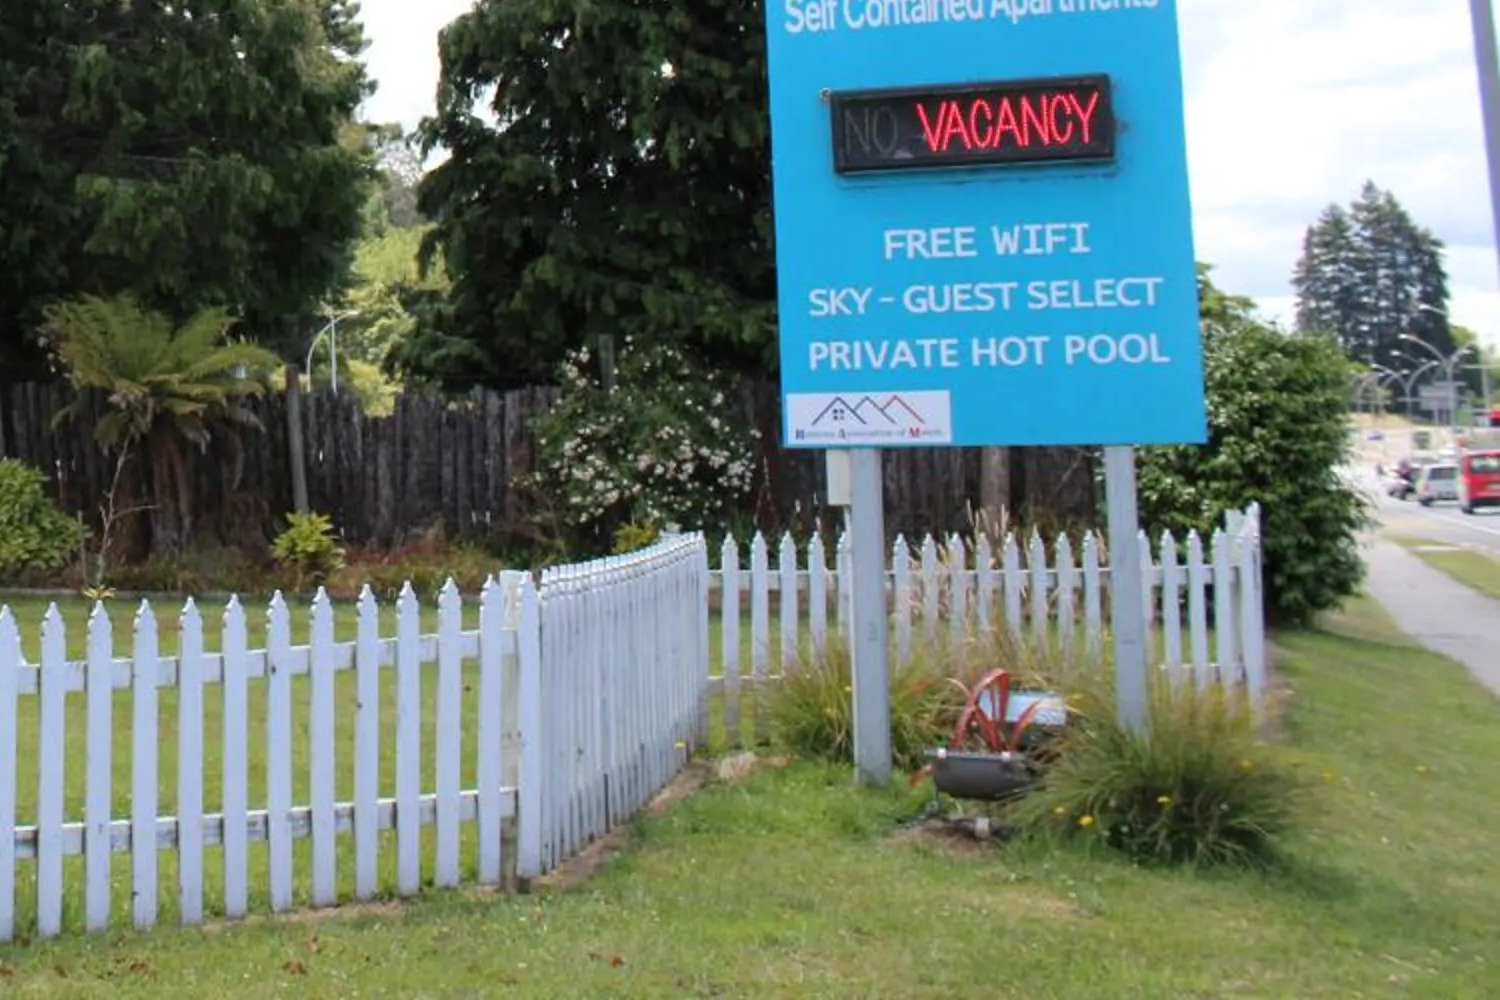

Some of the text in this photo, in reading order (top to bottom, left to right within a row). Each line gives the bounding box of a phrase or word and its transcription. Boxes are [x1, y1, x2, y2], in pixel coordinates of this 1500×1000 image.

[845, 91, 1099, 152] NO VACANCY
[885, 223, 1090, 258] FREE WIFI
[810, 288, 871, 316] SKY
[904, 283, 1017, 312] GUEST
[1028, 278, 1162, 309] SELECT
[810, 334, 1170, 369] PRIVATE HOT POOL
